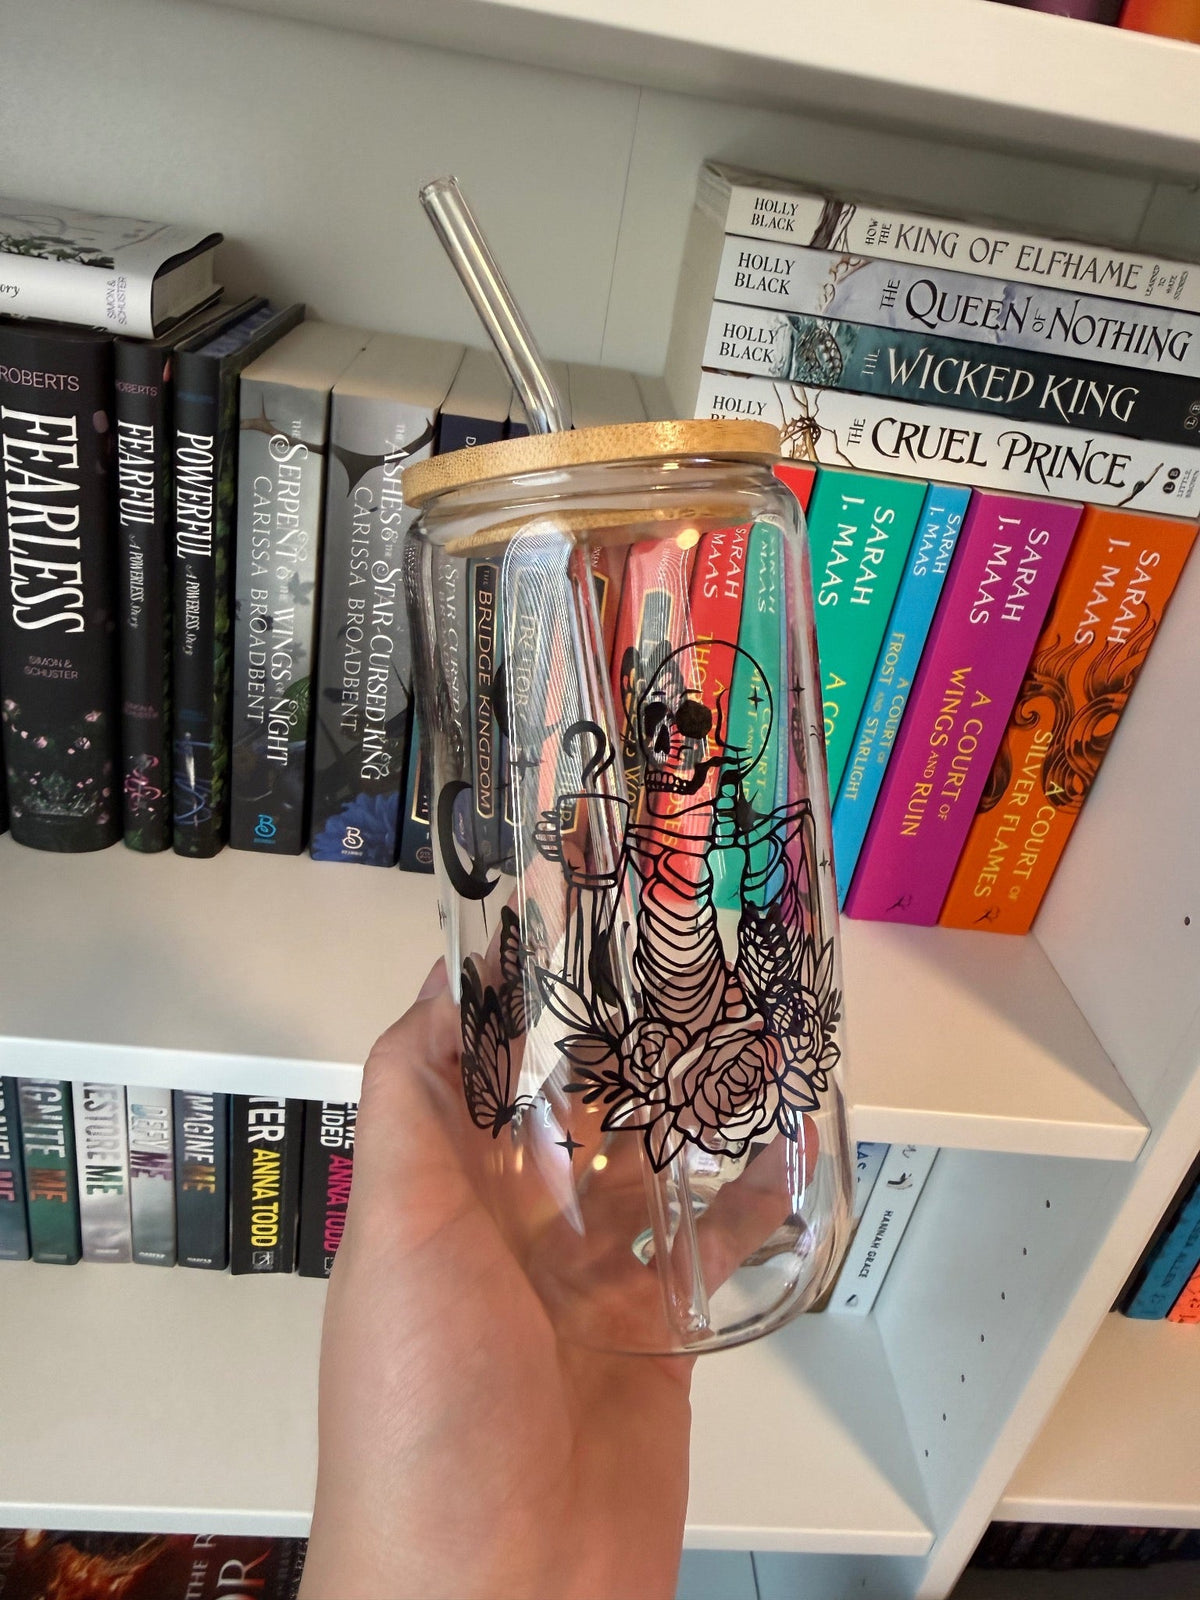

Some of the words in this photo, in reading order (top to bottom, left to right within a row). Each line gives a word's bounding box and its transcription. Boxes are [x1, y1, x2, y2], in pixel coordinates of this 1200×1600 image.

[750, 214, 796, 233] BLACK
[754, 197, 799, 216] HOLLY
[865, 217, 879, 246] HOW
[877, 222, 892, 246] THE
[738, 251, 796, 276] HOLLY
[894, 222, 960, 259] KING
[969, 236, 1010, 265] OF
[1015, 245, 1144, 290] ELFHAME
[733, 273, 791, 296] BLACK
[880, 278, 901, 309] THE
[722, 323, 779, 346] HOLLY
[905, 278, 1033, 335] QUEEN
[1032, 312, 1046, 333] OF
[1046, 297, 1191, 362] NOTHING
[0, 365, 80, 392] ROBERTS
[718, 342, 775, 364] BLACK
[712, 395, 768, 416] HOLLY
[887, 346, 1037, 405] WICKED
[1039, 374, 1140, 424] KING
[847, 417, 866, 447] THE
[870, 416, 988, 469] CRUEL
[996, 430, 1132, 492] PRINCE
[117, 419, 155, 527] FEARFUL
[176, 429, 214, 559] POWERFUL
[269, 433, 309, 564] SERPENT
[380, 440, 411, 525] ASHES
[1, 404, 85, 633] FEARLESS
[251, 475, 273, 577] CARISSA
[841, 493, 866, 511] J.
[929, 506, 945, 517] J.
[998, 514, 1021, 531] J.
[348, 486, 374, 587] CARISSA
[724, 528, 747, 599] SARAH
[850, 505, 895, 605] SARAH
[912, 523, 938, 577] MAAS
[932, 512, 962, 575] SARAH
[1108, 537, 1131, 553] J.
[129, 551, 145, 603] POWERLESS
[703, 533, 727, 599] MAAS
[818, 523, 858, 607] MAAS
[968, 542, 1009, 625] MAAS
[1001, 526, 1050, 623] SARAH
[185, 581, 200, 630] POWERLESS
[1073, 564, 1122, 647] MAAS
[1106, 549, 1161, 646] SARAH
[247, 588, 269, 724] BROADBENT
[270, 607, 295, 681] WINGS
[340, 598, 366, 732] BROADBENT
[477, 590, 493, 687] BRIDGE
[879, 632, 905, 687] FROST
[825, 671, 847, 690] A
[897, 676, 909, 689] A
[929, 666, 973, 748] WINGS
[970, 689, 992, 709] A
[266, 696, 299, 767] NIGHT
[880, 694, 906, 750] COURT
[360, 726, 393, 781] KING
[477, 694, 491, 809] KINGDOM
[844, 716, 880, 801] STARLIGHT
[922, 751, 940, 779] AND
[940, 718, 983, 803] COURT
[1008, 727, 1053, 807] SILVER
[900, 781, 933, 837] RUIN
[937, 803, 952, 821] OF
[1044, 779, 1065, 797] A
[973, 813, 1021, 898] FLAMES
[1012, 805, 1057, 881] COURT
[31, 1168, 68, 1203] ME
[85, 1165, 124, 1195] ME
[130, 1150, 172, 1181] ME
[182, 1164, 216, 1194] ME
[251, 1148, 281, 1201] ANNA
[326, 1153, 353, 1205] ANNA
[251, 1201, 280, 1248] TODD
[871, 1210, 894, 1249] HANNAH
[857, 1249, 877, 1279] GRACE
